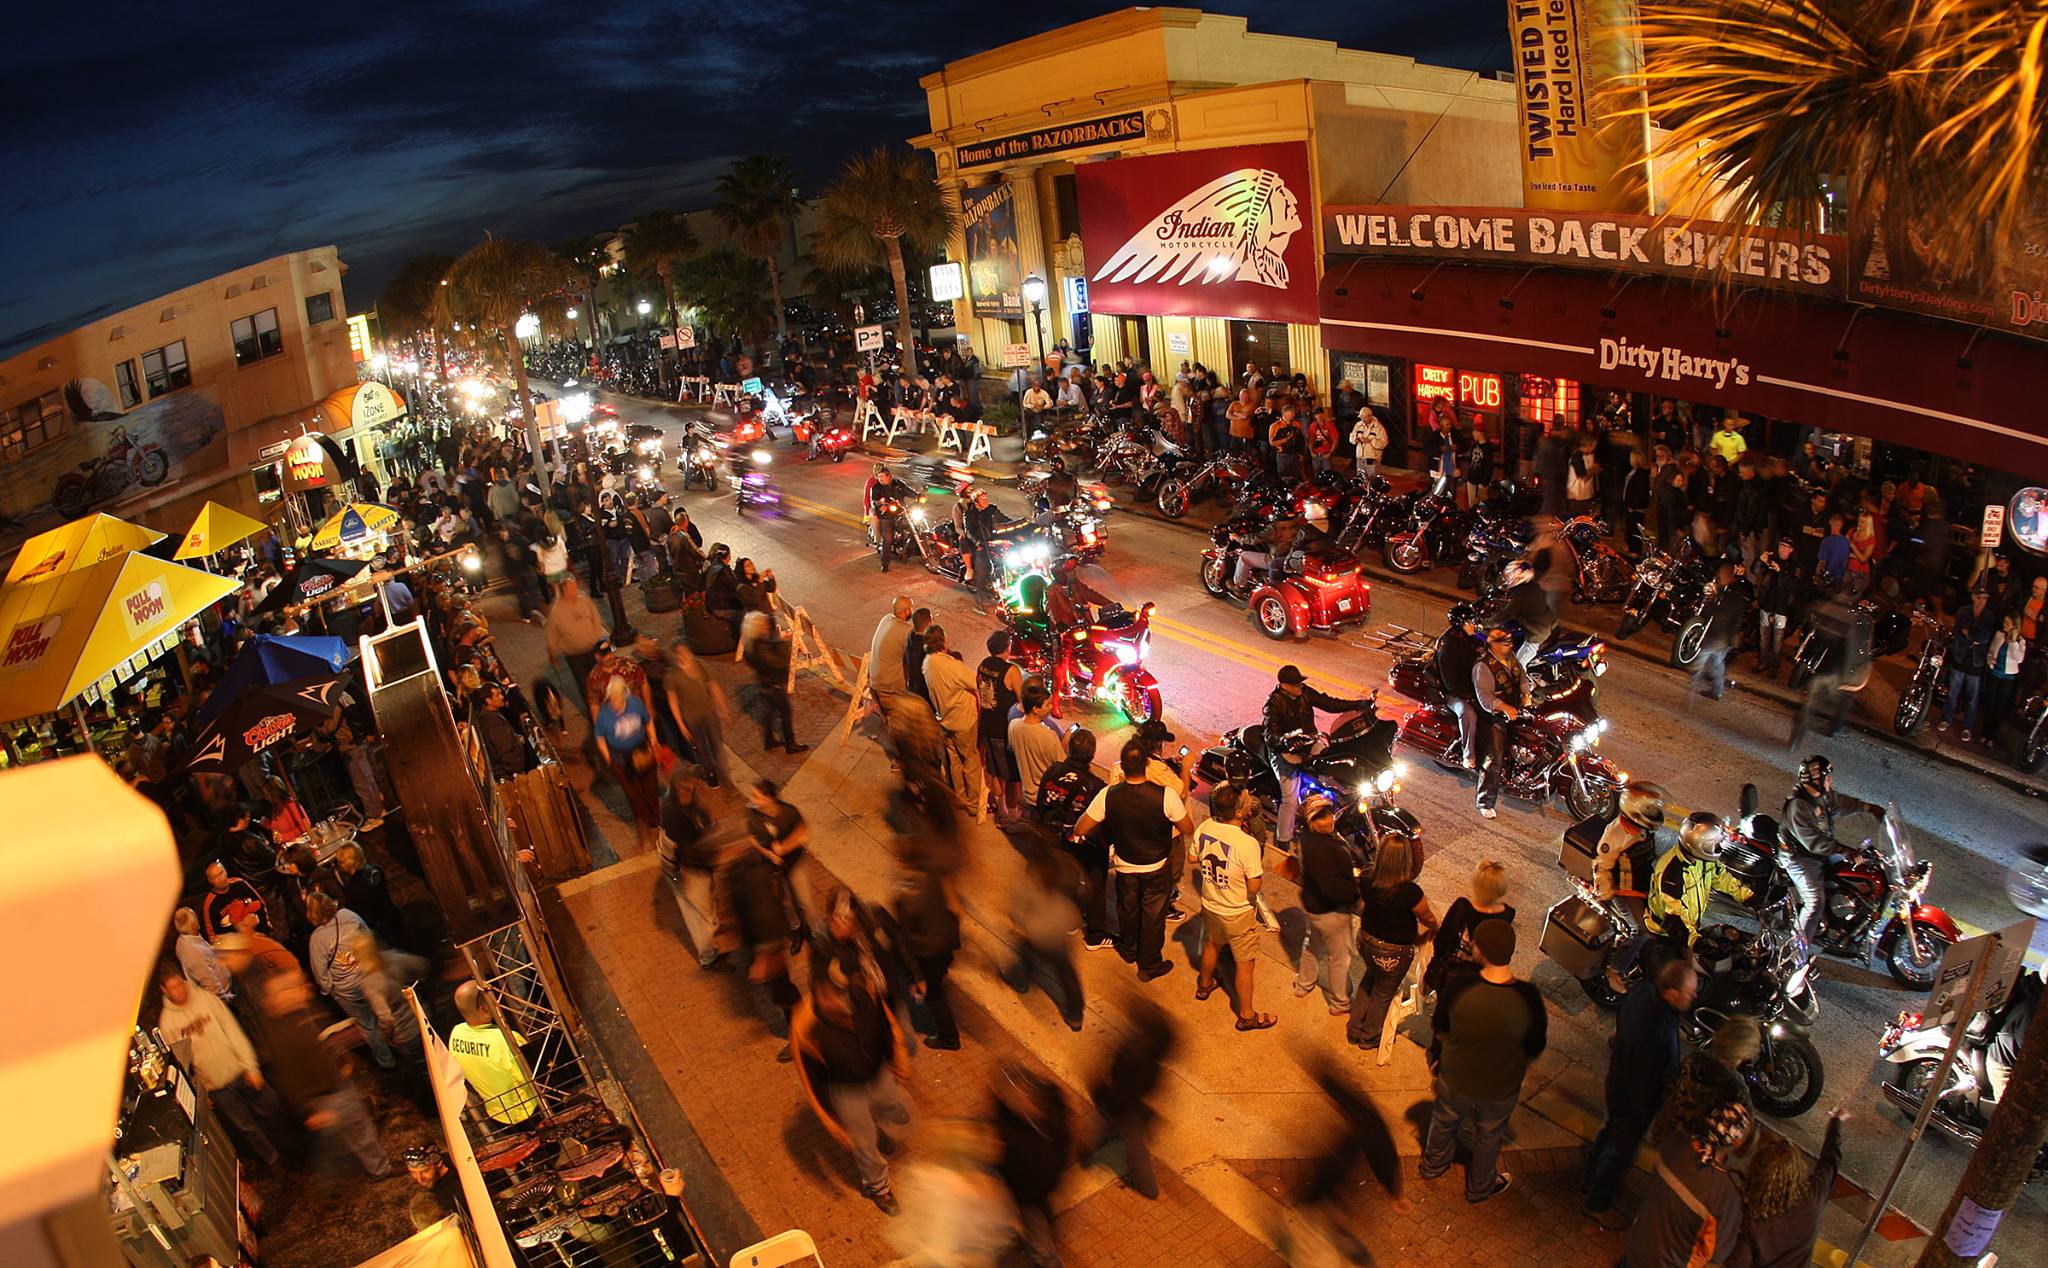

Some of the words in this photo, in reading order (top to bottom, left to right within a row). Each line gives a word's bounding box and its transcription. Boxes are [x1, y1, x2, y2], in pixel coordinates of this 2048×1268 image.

[1516, 0, 1541, 22] T
[1547, 30, 1571, 74] Iced
[1521, 27, 1554, 162] TWISTED
[1553, 81, 1577, 136] Hard
[960, 148, 992, 164] Home
[994, 142, 1007, 157] of
[1008, 139, 1029, 154] the
[1032, 115, 1143, 150] RAZORBACKS
[1530, 182, 1541, 190] True
[1543, 182, 1556, 191] Iced
[1558, 183, 1572, 191] Tea
[1574, 183, 1597, 192] Taste
[963, 182, 1013, 229] RAZORBACKS
[1156, 209, 1236, 241] Indian
[1160, 241, 1235, 249] MOTORCYCLE
[1335, 214, 1516, 252] WELCOME
[1528, 217, 1650, 264] BACK
[1663, 226, 1832, 285] BIKERS
[1422, 367, 1449, 383] DIRTY
[1600, 336, 1661, 378] Dirty
[1660, 346, 1750, 390] Harry's
[1417, 383, 1454, 402] HARRY'S
[1458, 374, 1500, 406] PUB
[291, 462, 324, 481] MOON
[97, 544, 124, 562] Indian
[306, 582, 334, 597] LIGHT
[133, 597, 165, 625] MOON
[3, 637, 51, 667] MOON
[243, 713, 296, 746] Coors
[252, 722, 296, 754] LIGHT
[452, 1037, 491, 1058] SECURITY
